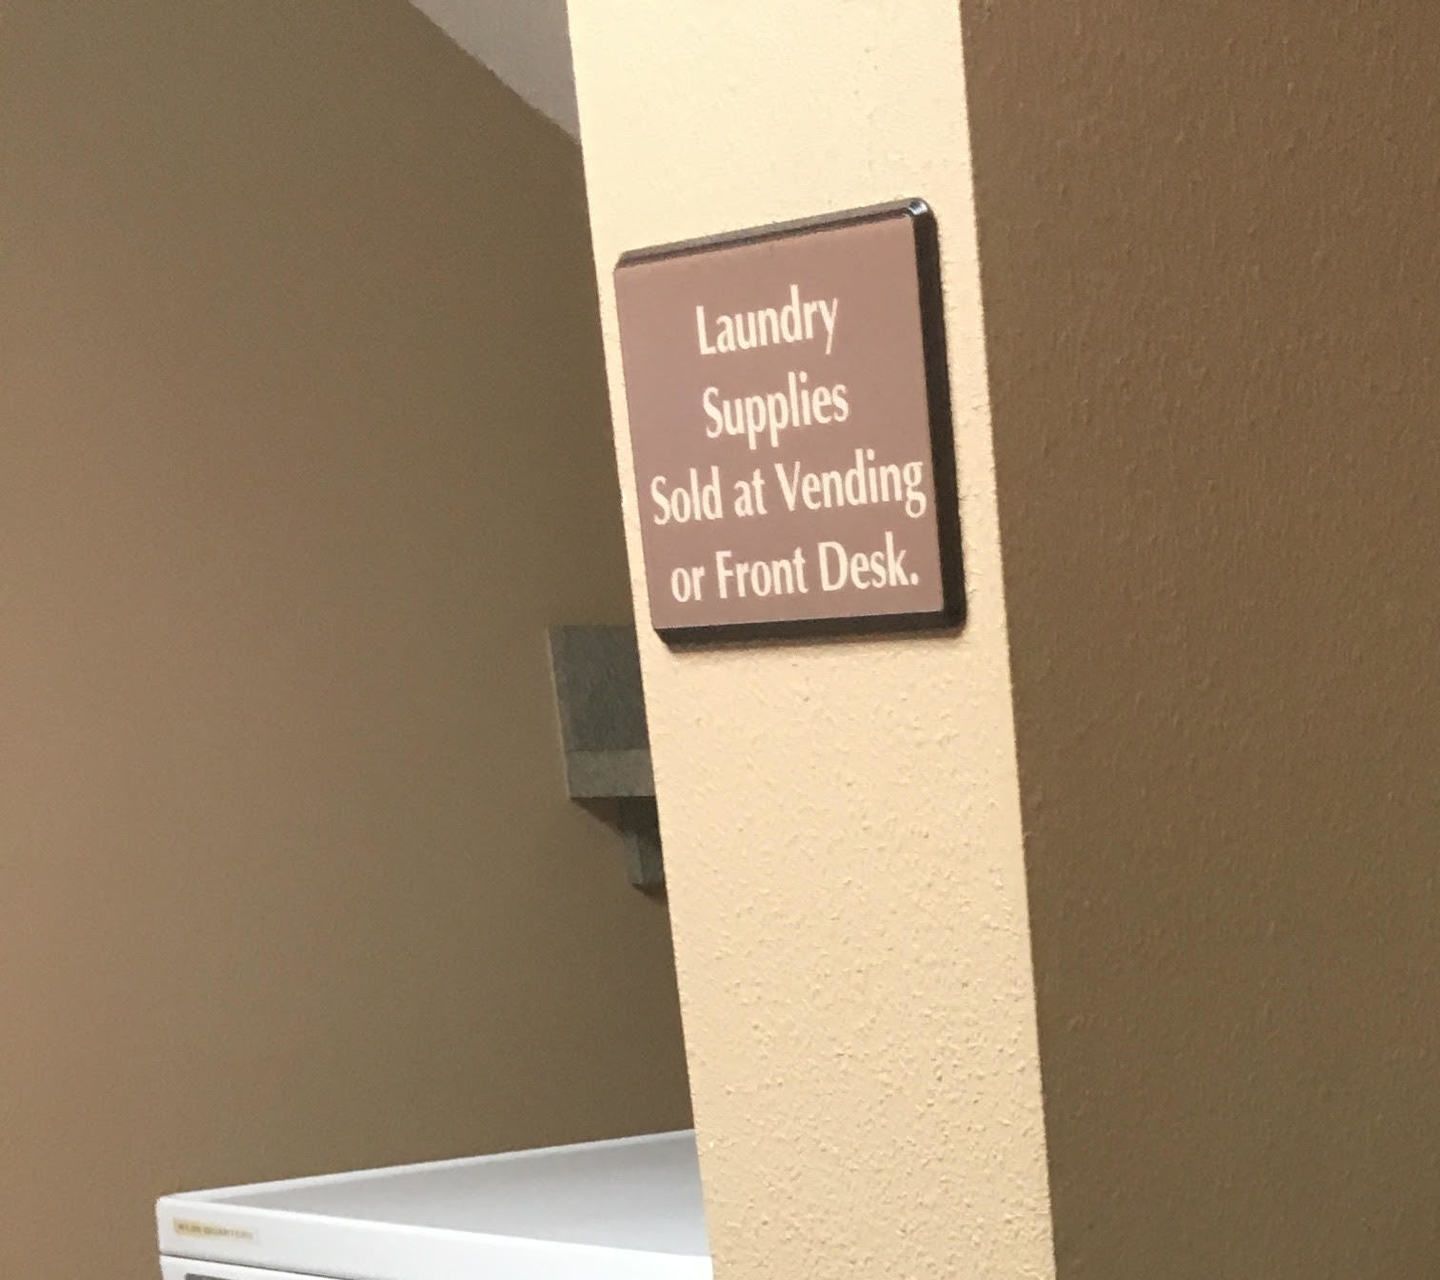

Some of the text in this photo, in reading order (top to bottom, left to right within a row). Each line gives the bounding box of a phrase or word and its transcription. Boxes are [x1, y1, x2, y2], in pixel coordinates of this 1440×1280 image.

[695, 283, 839, 356] Laundry
[702, 371, 850, 451] Supplies
[650, 447, 927, 526] Sold at Vending
[670, 530, 920, 603] or Front Desk.
